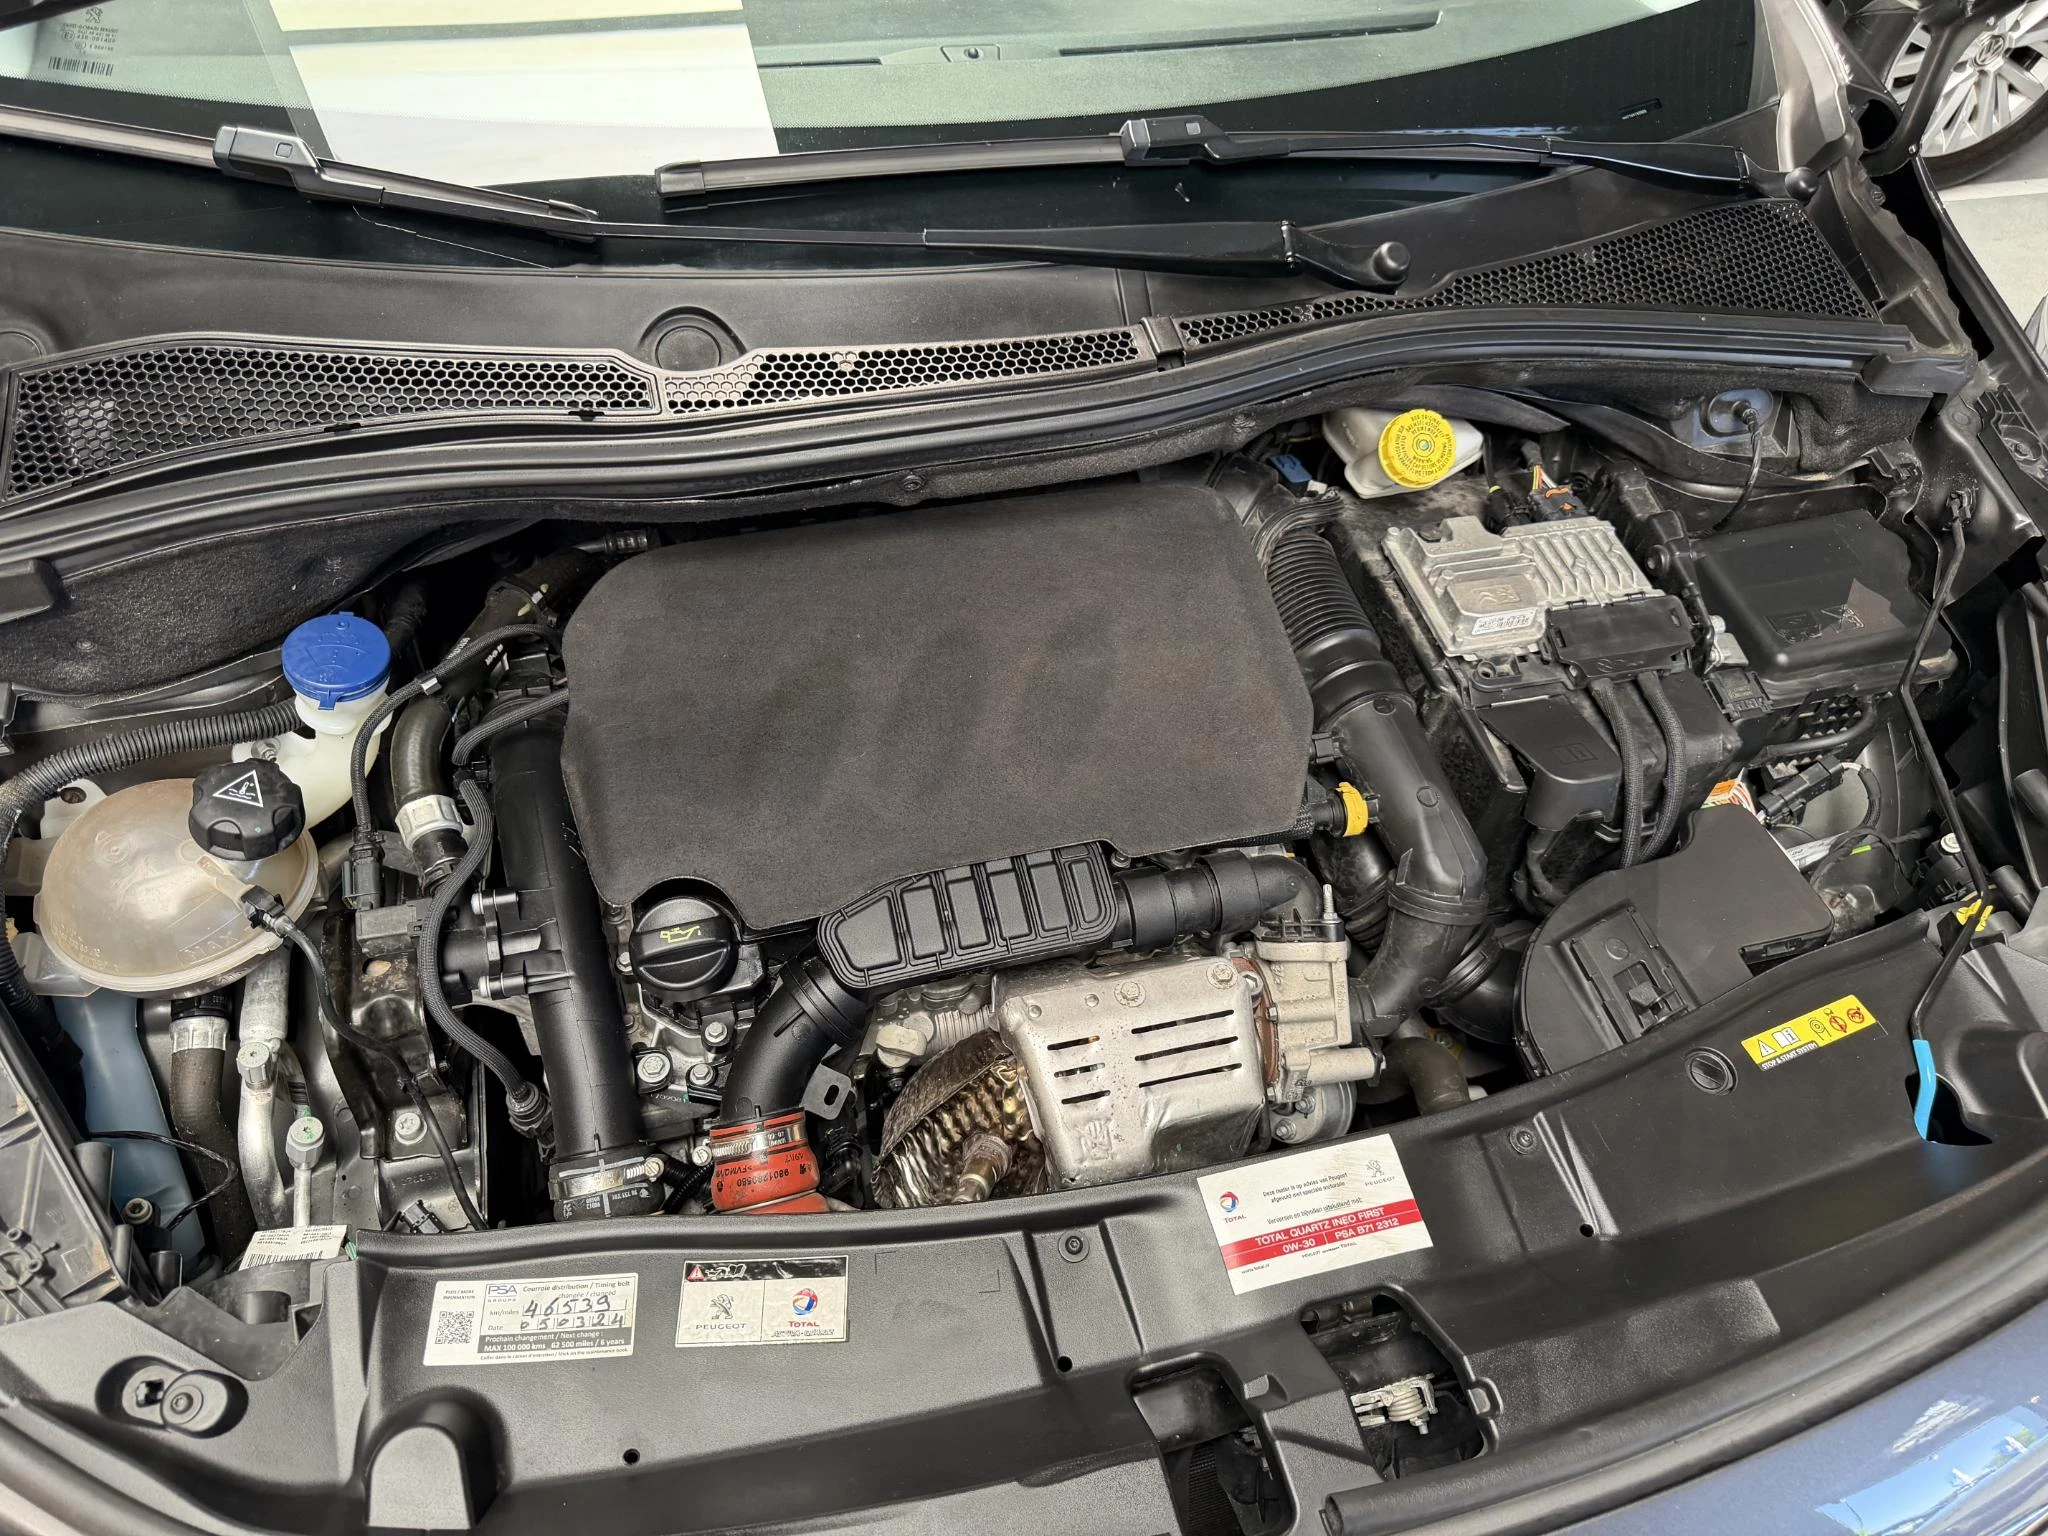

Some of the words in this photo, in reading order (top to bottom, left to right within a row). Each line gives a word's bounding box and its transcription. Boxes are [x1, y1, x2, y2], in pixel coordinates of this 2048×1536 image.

[1762, 1060, 1776, 1070] STOP
[1782, 1050, 1797, 1061] START
[1797, 1042, 1818, 1055] SYSTEM
[1224, 1214, 1246, 1224] TOTAL
[1255, 1233, 1288, 1246] TOTAL
[1289, 1222, 1331, 1237] QUARTZ
[1332, 1215, 1356, 1227] INEO
[1358, 1208, 1385, 1221] FIRST
[1282, 1238, 1316, 1253] 0W-30
[1335, 1228, 1356, 1240] PSA
[1357, 1223, 1375, 1236] B71
[1376, 1217, 1399, 1231] 2312
[488, 1285, 517, 1295] PSA
